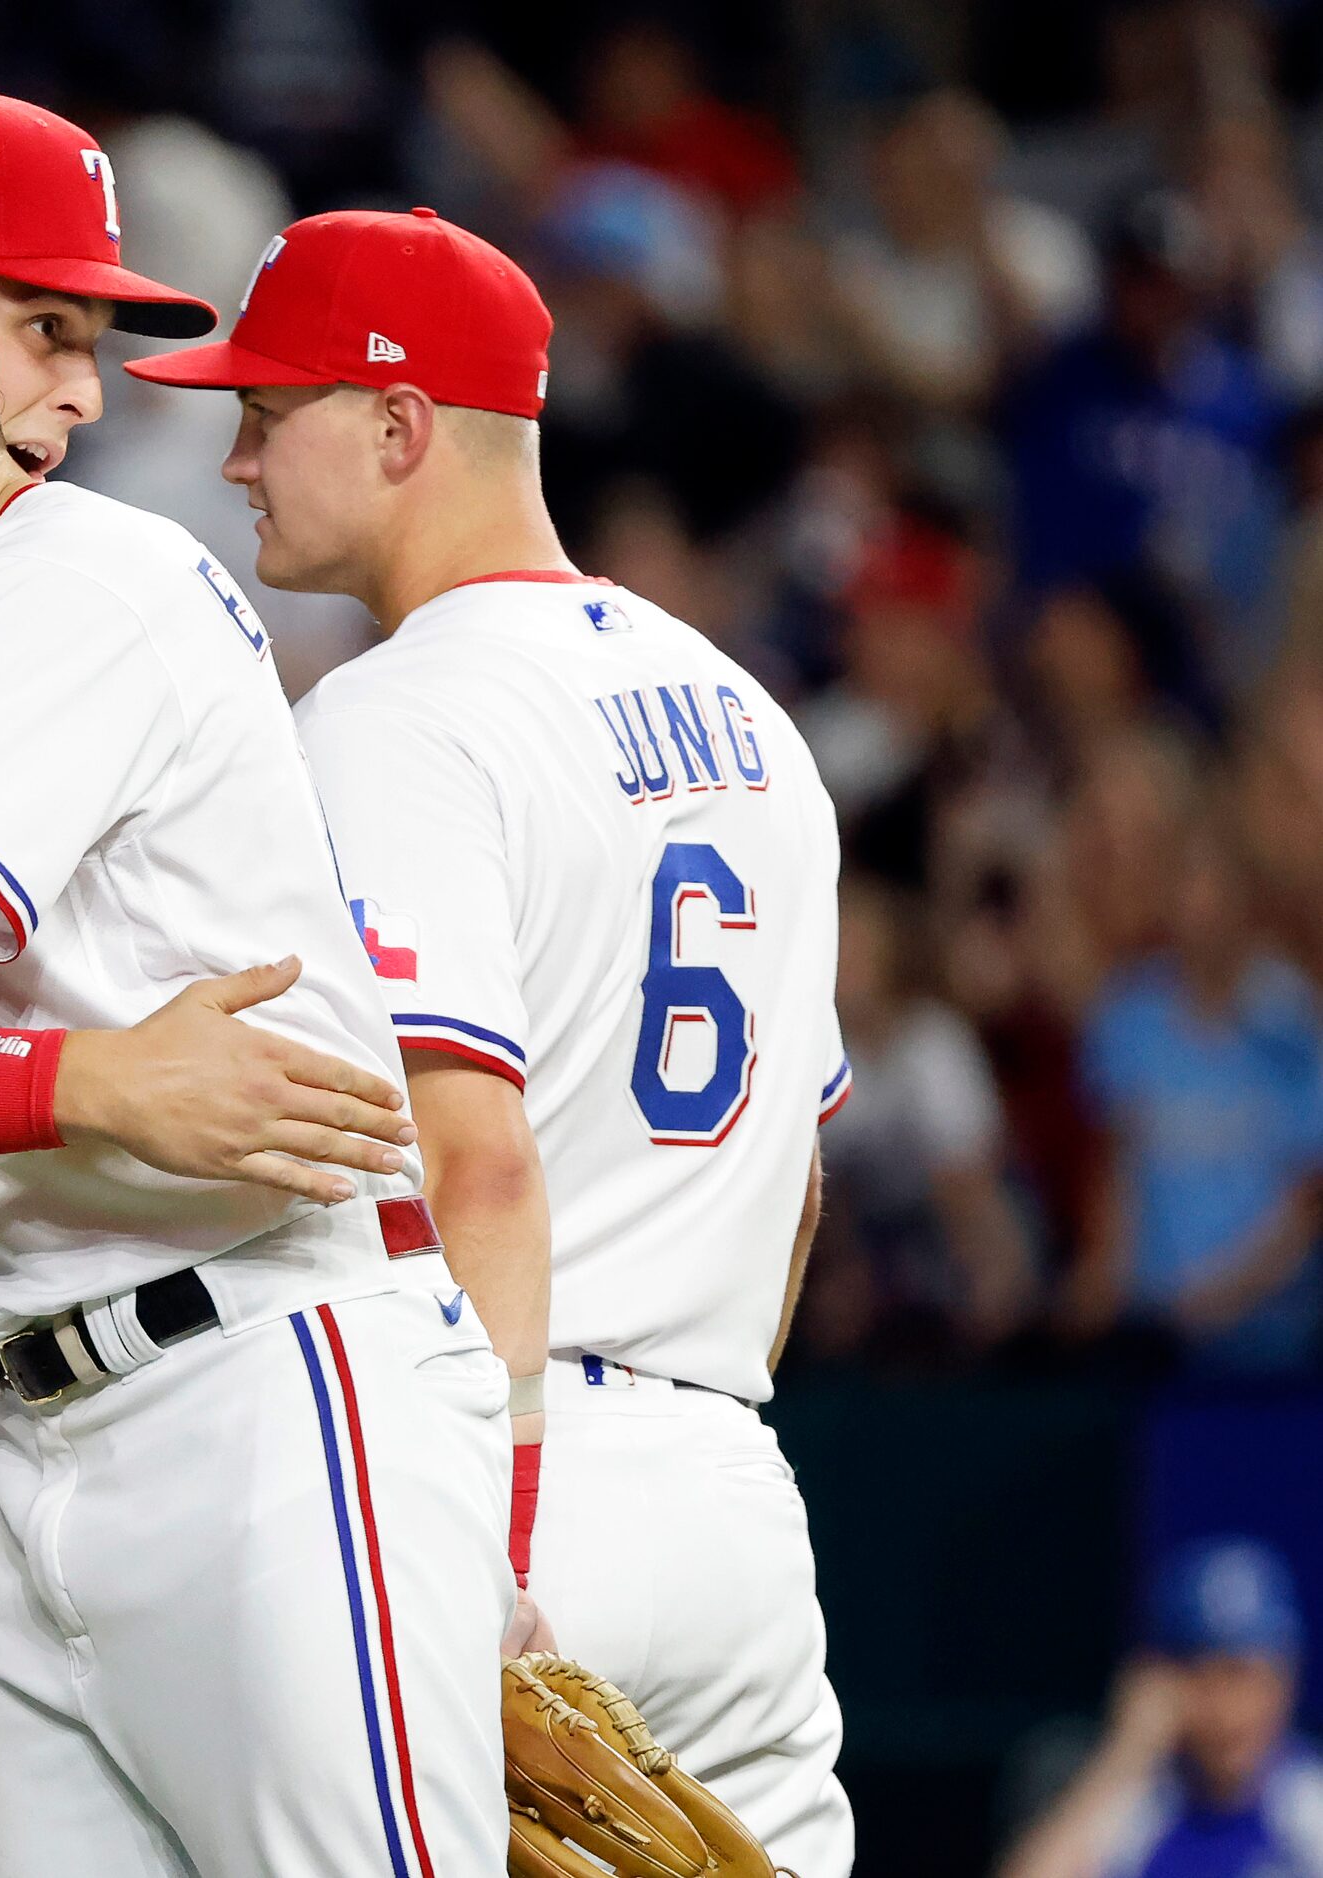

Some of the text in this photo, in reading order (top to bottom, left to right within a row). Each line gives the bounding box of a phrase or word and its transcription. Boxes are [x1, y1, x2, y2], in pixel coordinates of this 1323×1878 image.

[80, 148, 121, 245] T
[593, 682, 770, 806] JUNG
[630, 842, 757, 1147] 6
